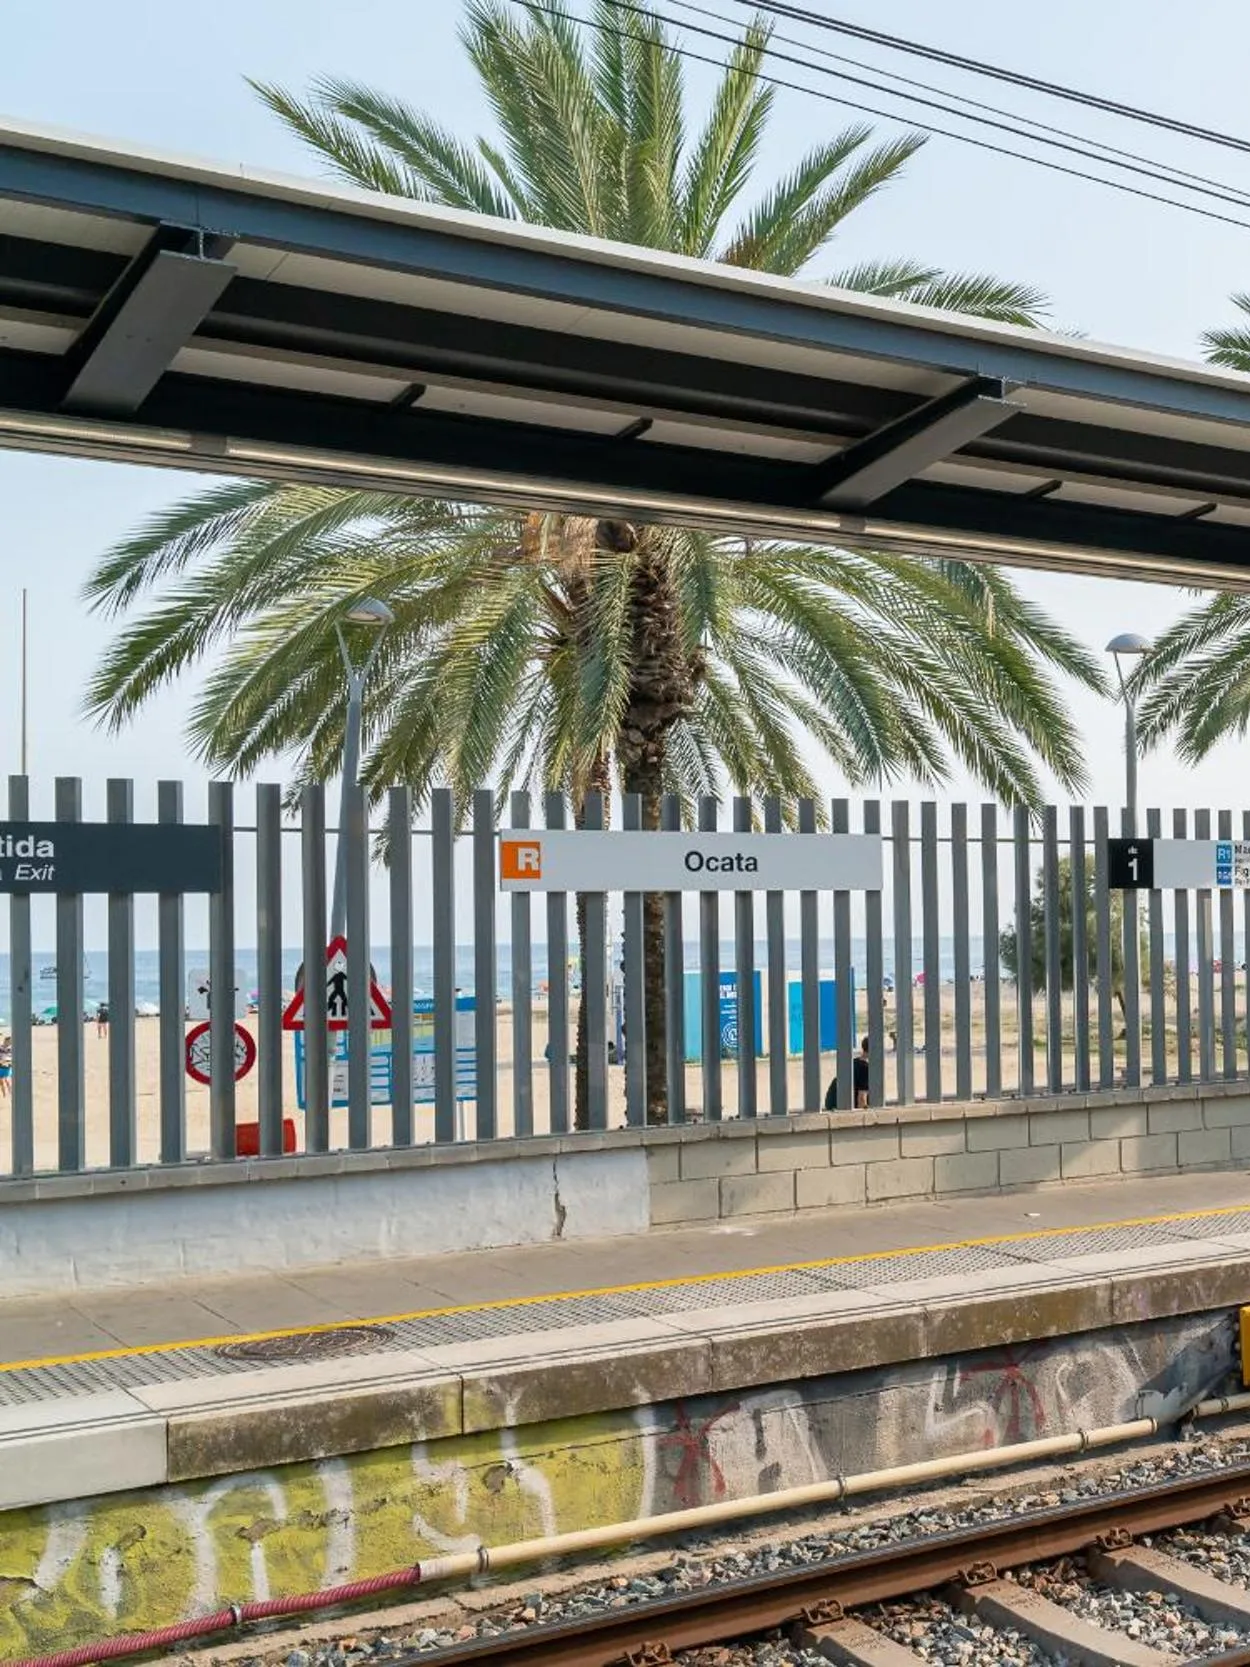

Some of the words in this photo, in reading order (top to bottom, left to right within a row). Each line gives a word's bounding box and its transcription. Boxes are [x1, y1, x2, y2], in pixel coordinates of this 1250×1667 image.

[517, 847, 540, 872] R
[684, 851, 758, 872] Ocata
[1127, 858, 1138, 881] 1
[14, 864, 55, 881] Exit
